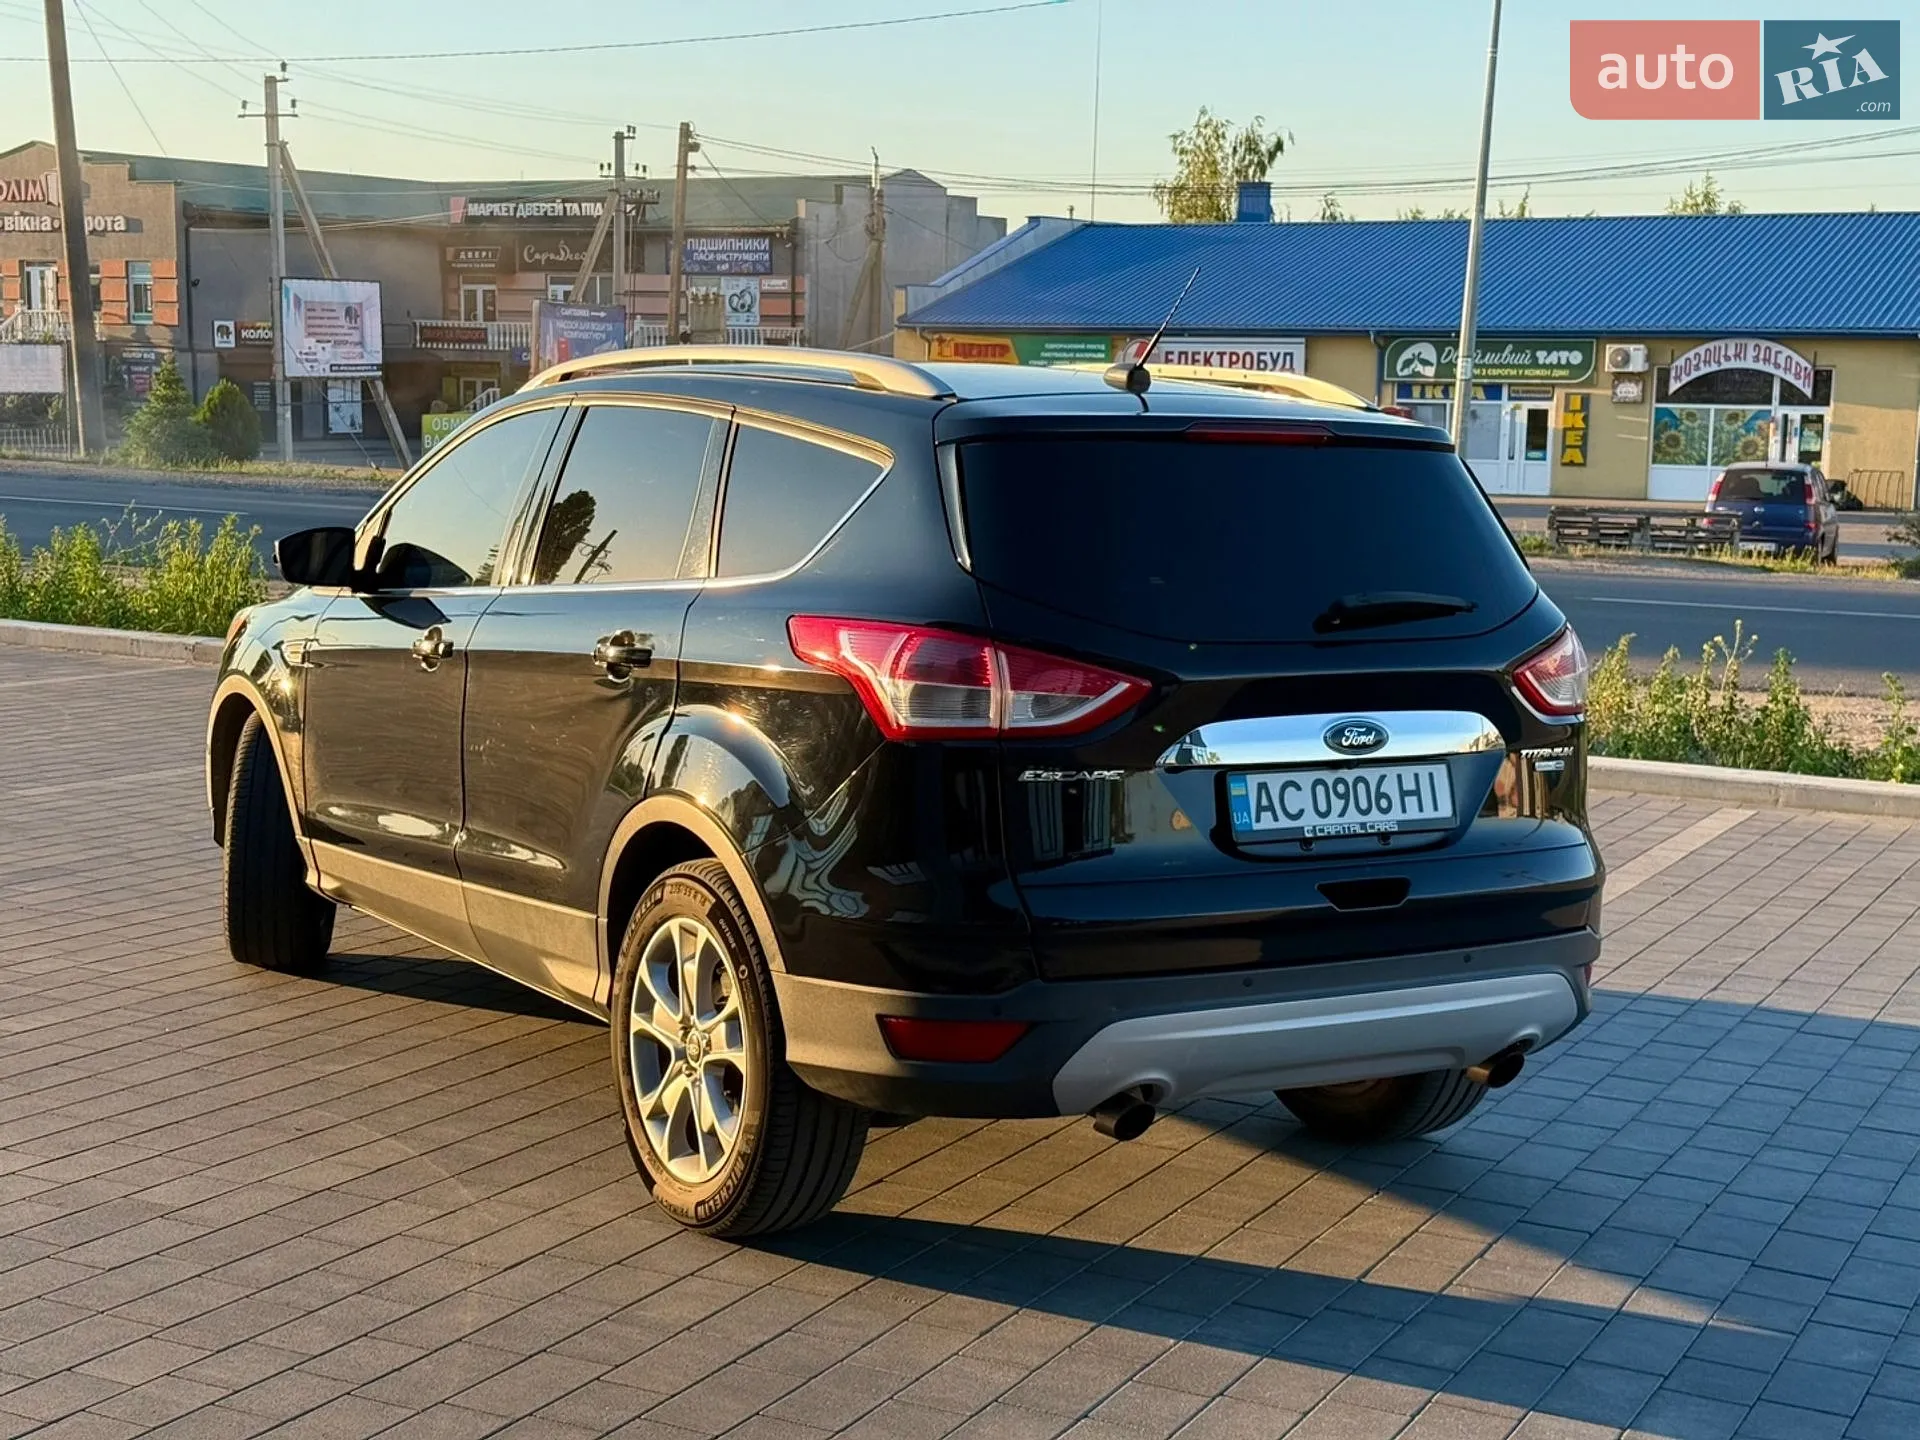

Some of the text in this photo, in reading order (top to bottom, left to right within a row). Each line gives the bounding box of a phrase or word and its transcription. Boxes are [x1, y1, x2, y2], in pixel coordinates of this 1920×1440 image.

[468, 202, 515, 216] МАРКЕТ
[515, 200, 564, 218] ДВЕРЕЙ
[565, 202, 581, 216] ТА
[84, 214, 127, 236] рота
[686, 238, 770, 251] ПІДШИПНИКИ
[241, 329, 273, 339] КОЛО
[1535, 350, 1584, 365] ТАТО
[1672, 342, 1812, 389] КОЗАЦЬКІ ЗАБАВИ
[1411, 385, 1486, 400] IKA
[1562, 395, 1585, 464] IKEA
[423, 434, 443, 449] ВА
[1341, 726, 1376, 747] Ford
[1017, 769, 1125, 781] ESCAPE
[1254, 771, 1440, 824] AC 0906 HI
[1233, 811, 1251, 825] UA
[1316, 822, 1365, 836] CAPITAL
[1367, 821, 1398, 833] CARS
[696, 1155, 747, 1220] MICHELIN
